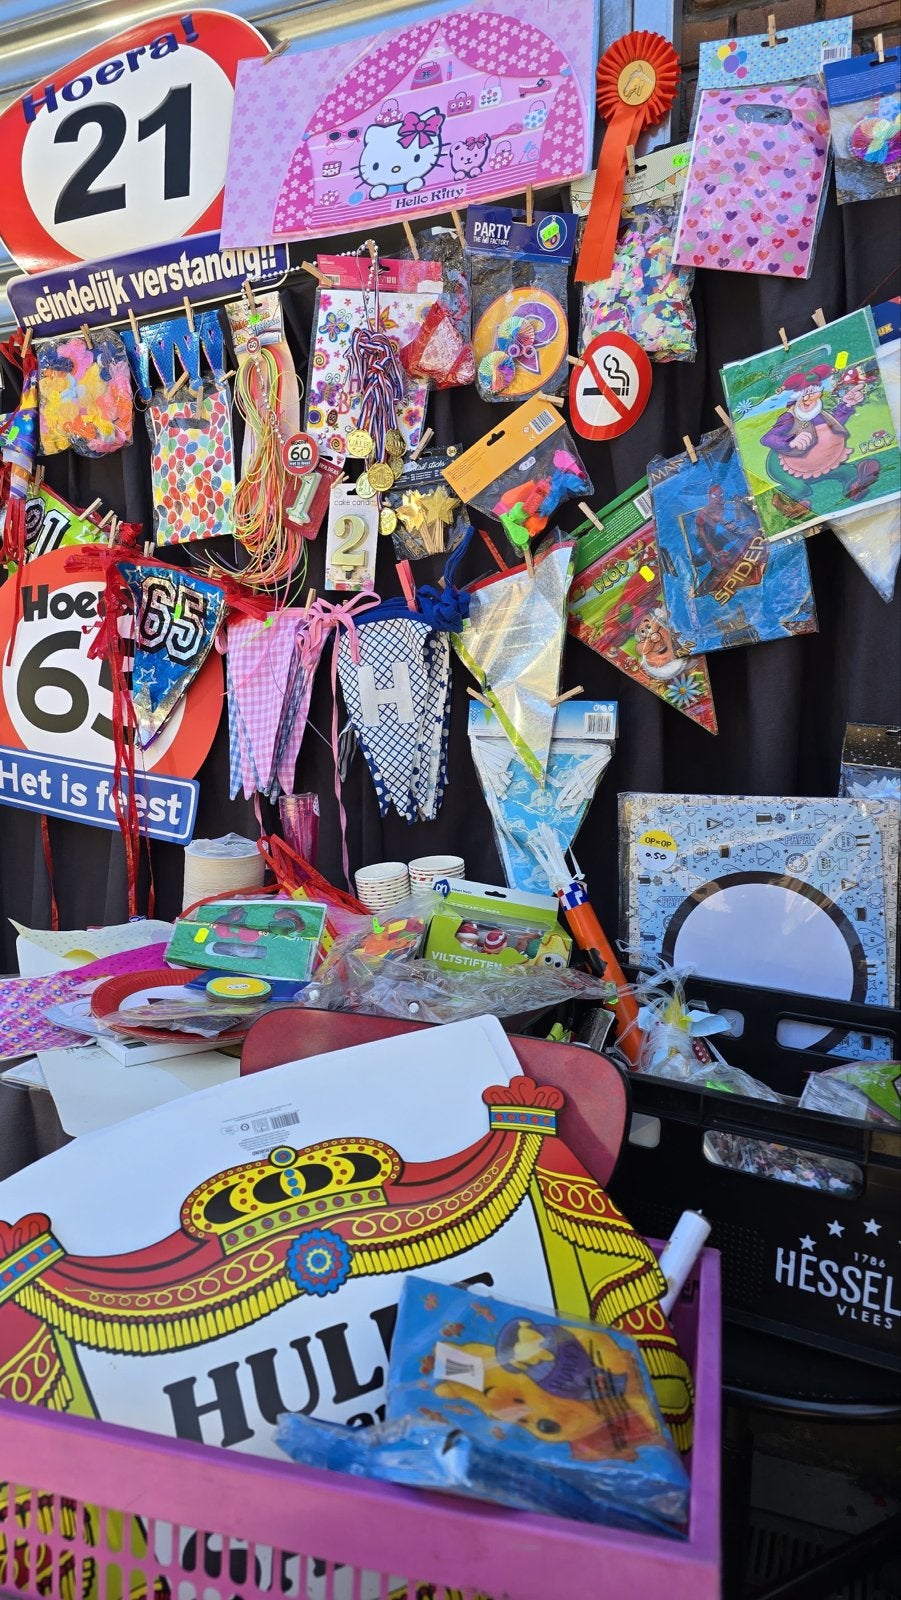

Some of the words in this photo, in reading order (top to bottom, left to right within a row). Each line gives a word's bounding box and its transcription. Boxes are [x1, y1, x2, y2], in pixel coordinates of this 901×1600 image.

[21, 13, 199, 124] Hoera!
[53, 83, 192, 225] 21
[395, 196, 429, 209] Hello
[431, 187, 464, 200] Kitty
[473, 221, 511, 240] PARTY
[22, 268, 132, 327] ...eindelijk
[129, 247, 277, 300] verstandig!!
[290, 446, 311, 460] 60
[651, 458, 684, 481] MAN
[330, 513, 369, 567] 2
[592, 559, 629, 594] PLOP
[714, 536, 766, 606] SPIDER
[137, 575, 207, 666] 65
[357, 661, 415, 728] H
[0, 760, 52, 800] Het
[60, 773, 88, 807] is
[95, 780, 182, 826] feest
[644, 836, 672, 848] OP=OP
[431, 951, 502, 969] VILTSTIFTEN
[854, 1252, 886, 1268] 1786
[837, 1303, 893, 1329] VLEES
